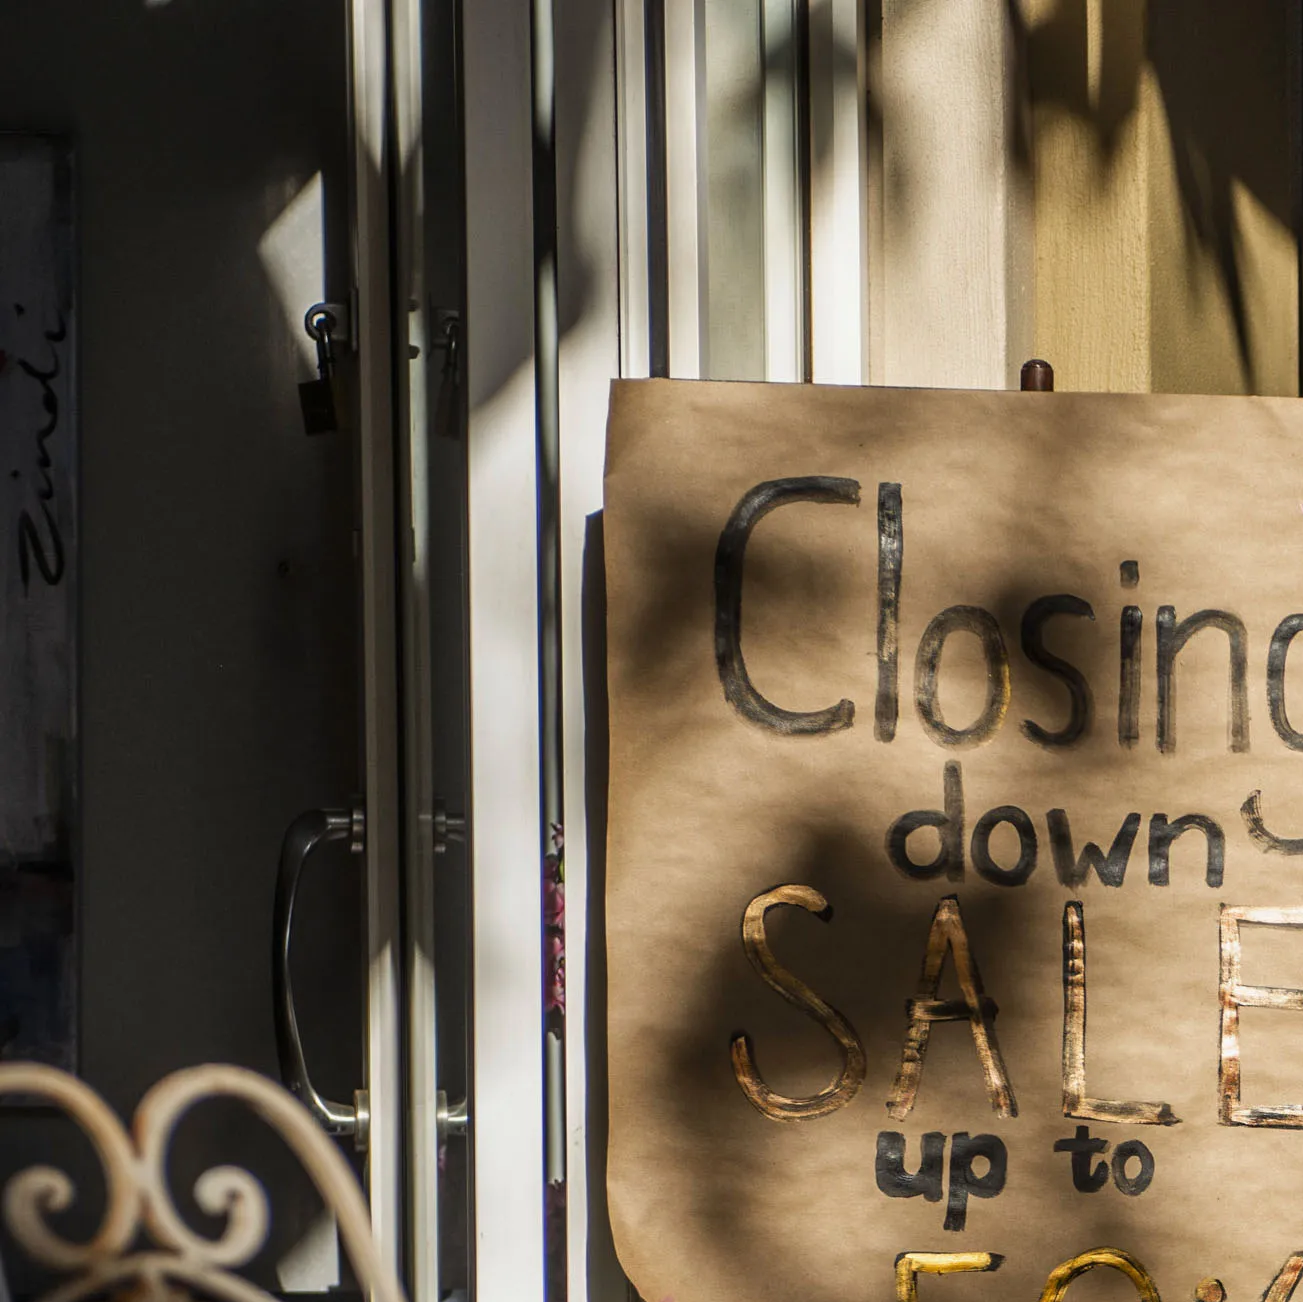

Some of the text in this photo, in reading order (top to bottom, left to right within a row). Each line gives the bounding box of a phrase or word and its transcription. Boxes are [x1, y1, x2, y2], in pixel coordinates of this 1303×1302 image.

[886, 761, 1227, 890] down
[875, 1125, 1157, 1232] up to
